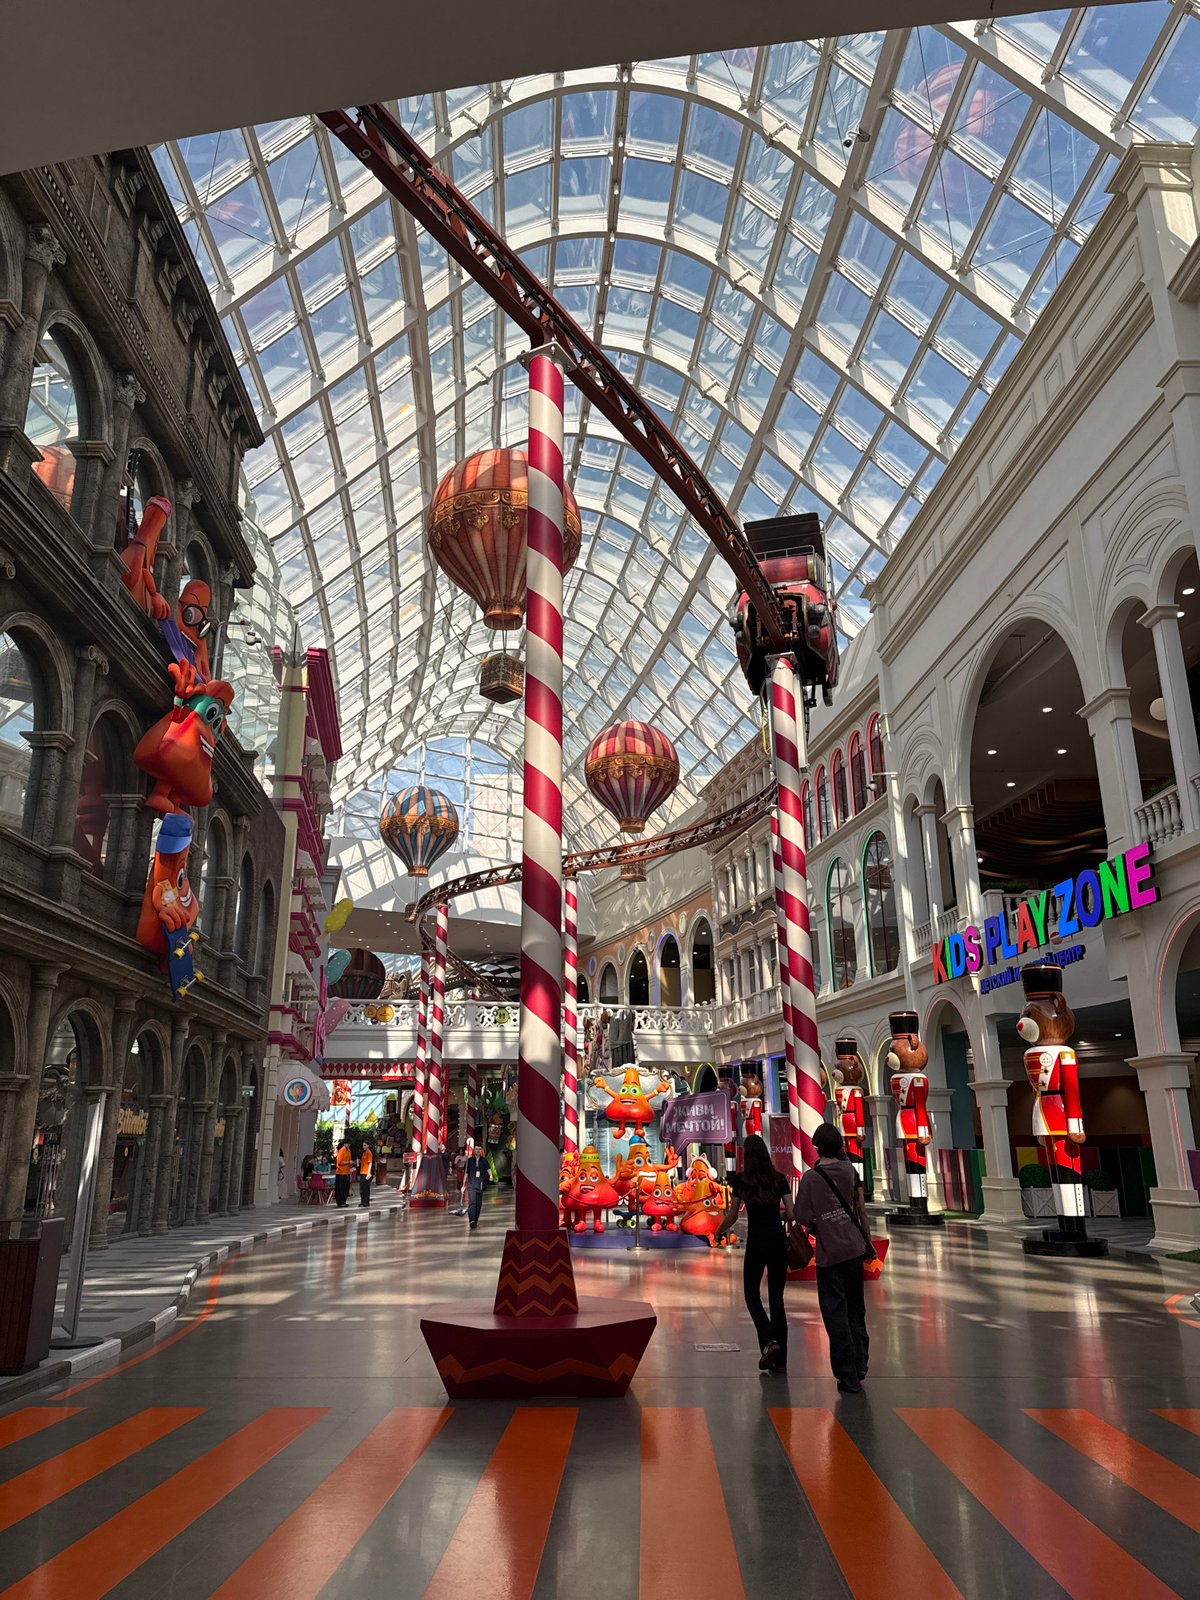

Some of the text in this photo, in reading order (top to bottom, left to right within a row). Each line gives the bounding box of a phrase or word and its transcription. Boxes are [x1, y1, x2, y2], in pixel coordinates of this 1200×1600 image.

[931, 925, 982, 985] KIDS
[984, 891, 1048, 965] PLAY
[1054, 841, 1158, 938] ZONE
[980, 966, 1014, 995] ДЕТСКИЙ
[673, 1103, 715, 1118] ЖИВИ
[665, 1115, 726, 1134] МЕЧТОЙ!
